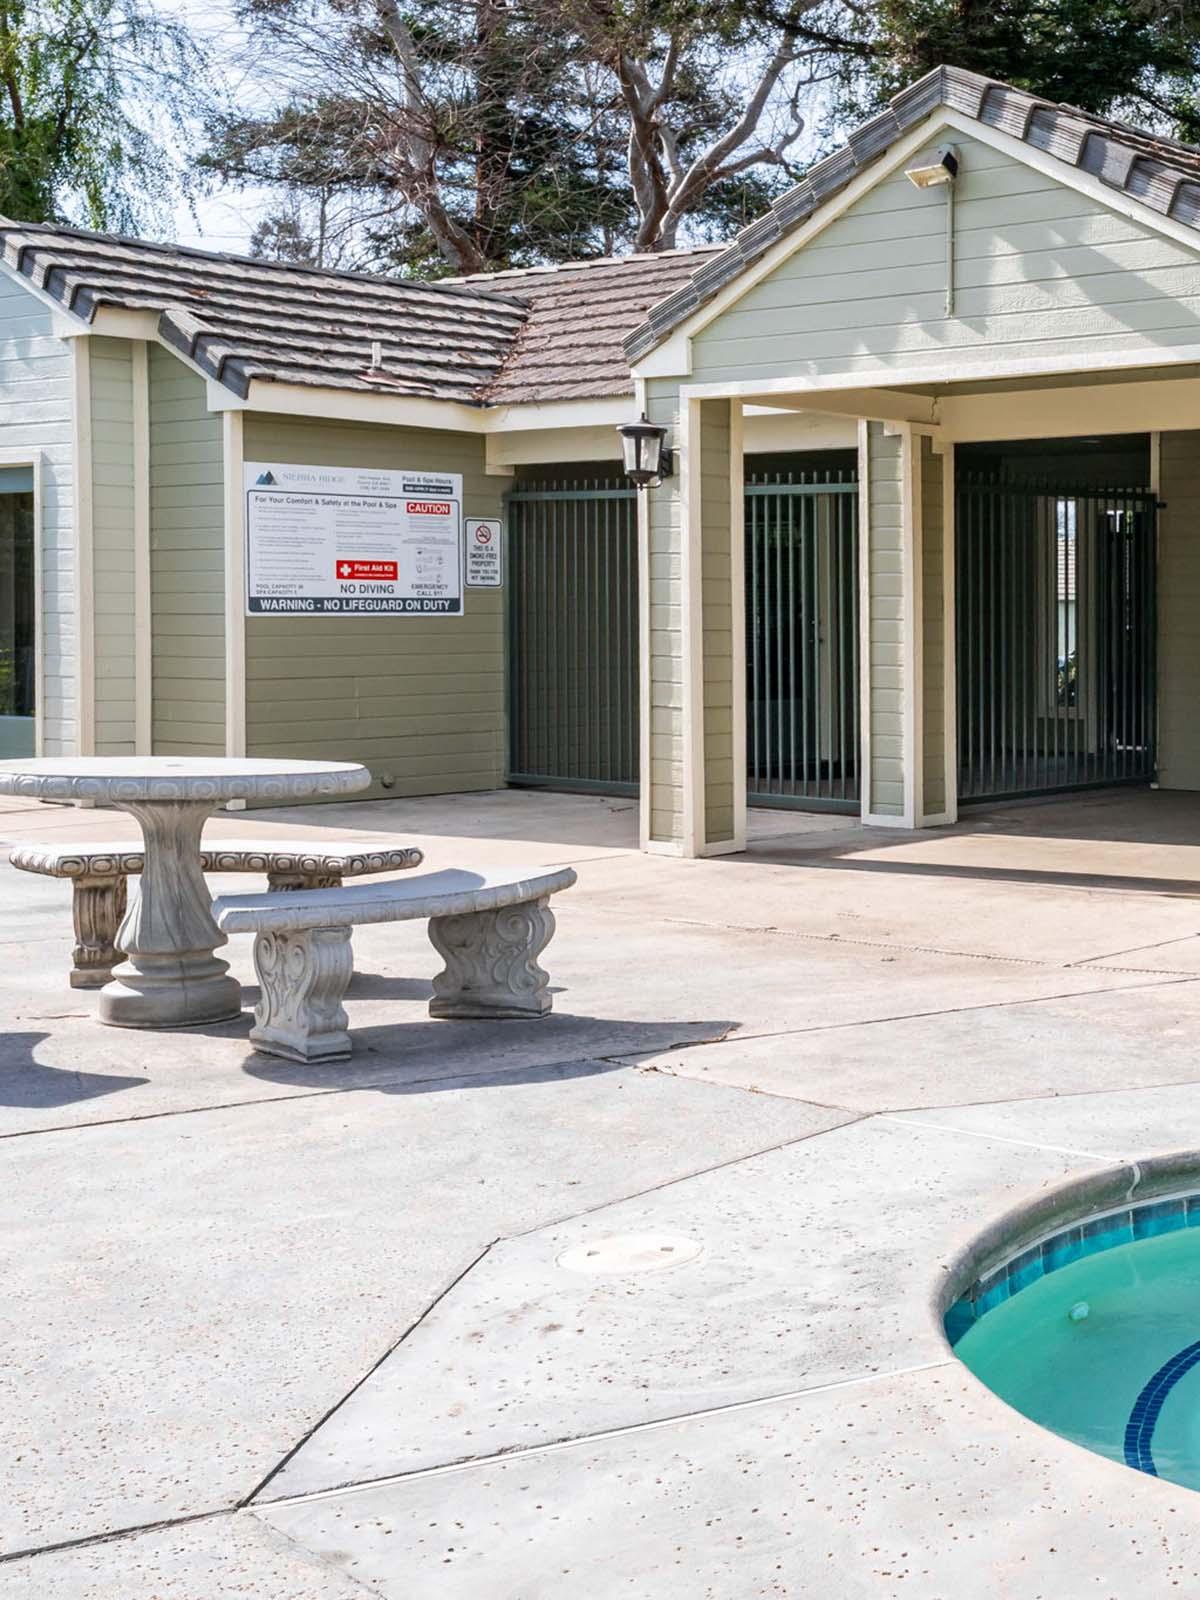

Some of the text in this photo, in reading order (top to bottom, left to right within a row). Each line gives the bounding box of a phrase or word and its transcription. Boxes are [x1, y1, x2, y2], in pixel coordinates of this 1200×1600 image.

[269, 496, 285, 504] Your
[286, 497, 313, 505] Comfort
[321, 498, 341, 507] Safety
[362, 500, 377, 508] Pool
[385, 501, 397, 509] Spa
[407, 503, 449, 514] CAUTION
[354, 563, 394, 572] First Aid Kit
[340, 583, 394, 594] NO DIVING
[260, 599, 314, 610] WARNING
[324, 599, 340, 610] NO
[343, 599, 403, 610] LIFEGUARD
[405, 599, 421, 610] ON
[424, 600, 450, 610] DUTY
